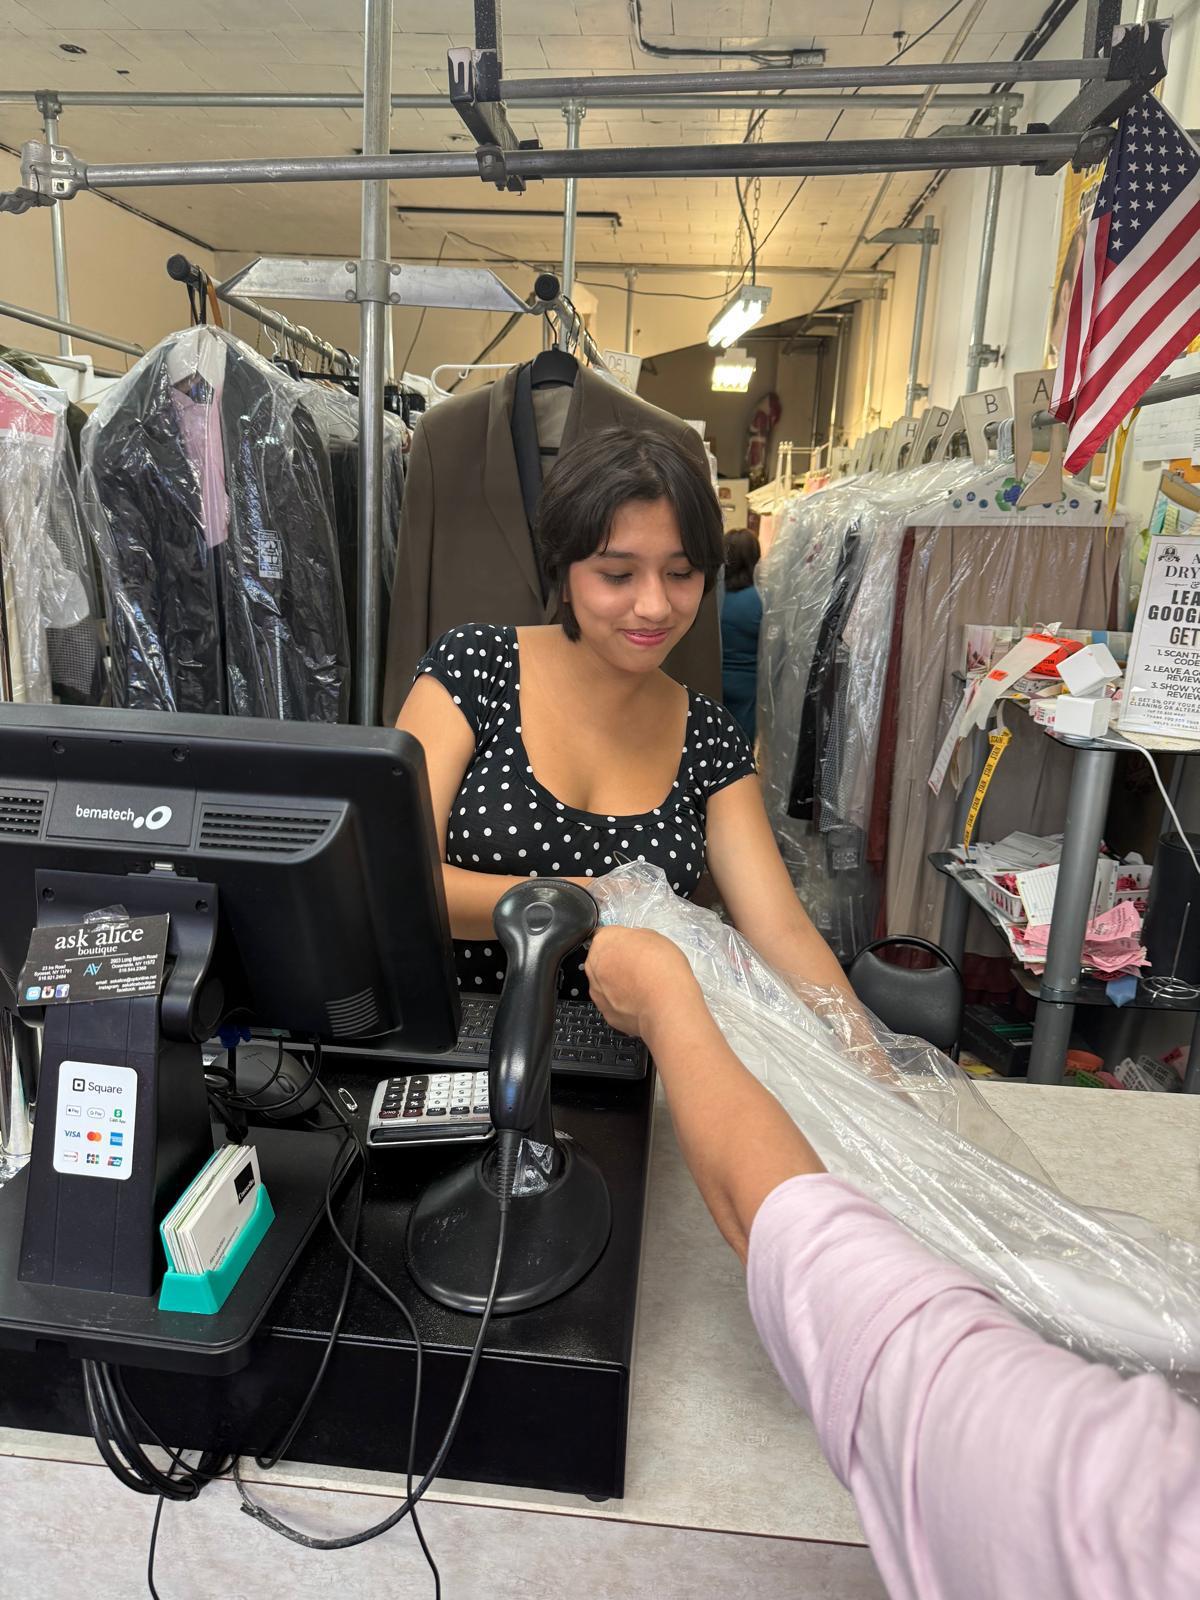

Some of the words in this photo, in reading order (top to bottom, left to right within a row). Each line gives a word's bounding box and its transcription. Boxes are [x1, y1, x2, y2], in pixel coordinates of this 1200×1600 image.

[1032, 378, 1050, 404] A
[984, 394, 999, 414] B
[936, 411, 949, 427] D
[905, 423, 917, 437] H
[1165, 565, 1200, 579] DRY
[1171, 590, 1200, 606] LEA
[1170, 626, 1200, 646] GET
[1164, 649, 1189, 658] SCAN
[1153, 665, 1182, 675] LEAVE
[1160, 682, 1189, 692] SHOW
[75, 804, 135, 821] bematech
[55, 928, 89, 950] ask
[95, 925, 144, 947] alice
[77, 945, 118, 956] boutique
[88, 1081, 123, 1094] Square
[64, 1130, 81, 1138] VISA
